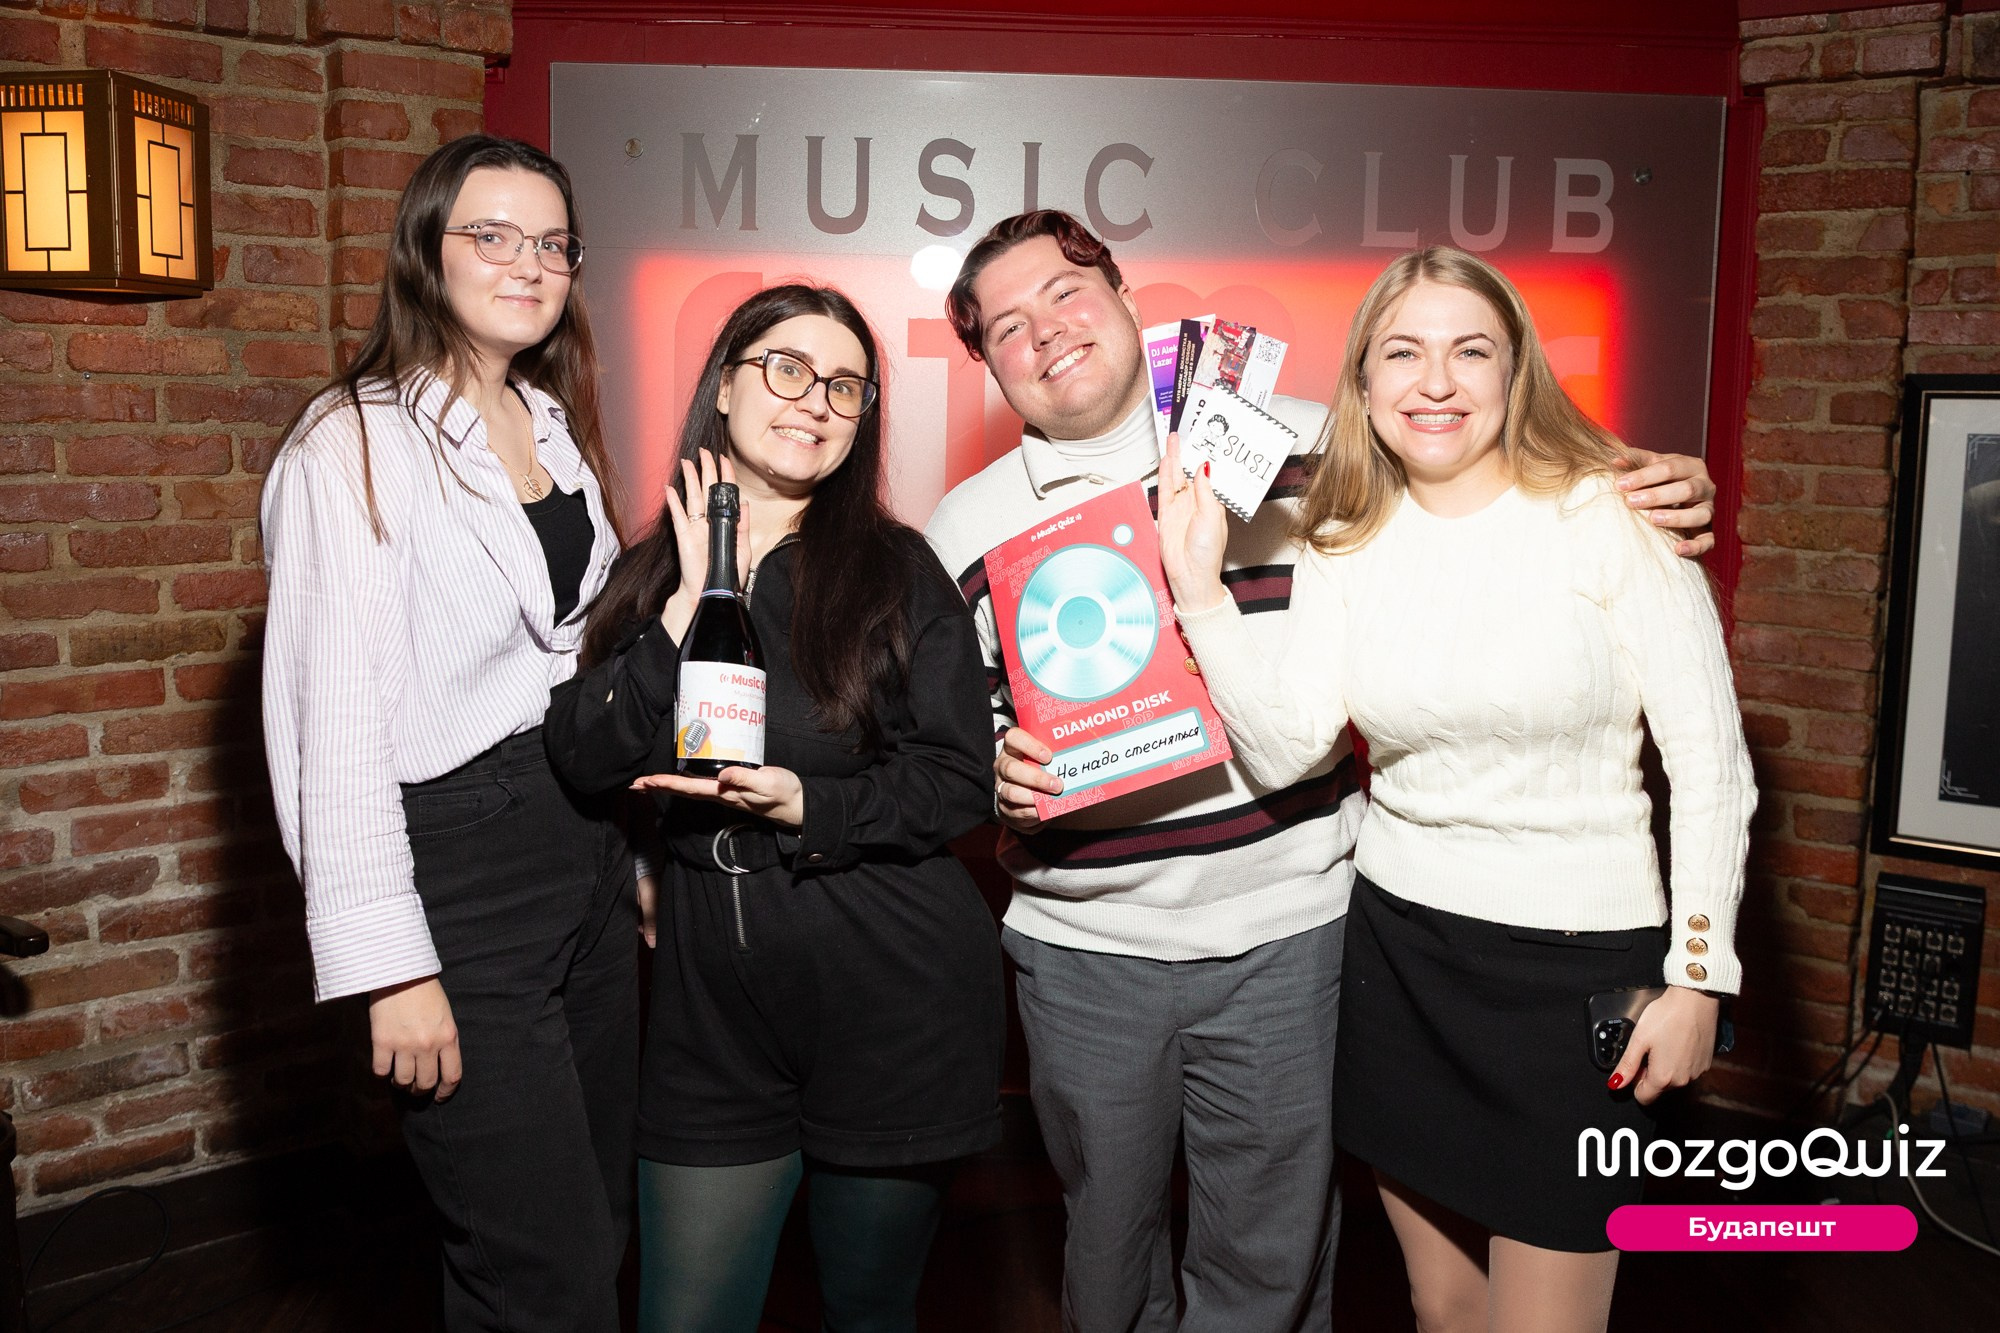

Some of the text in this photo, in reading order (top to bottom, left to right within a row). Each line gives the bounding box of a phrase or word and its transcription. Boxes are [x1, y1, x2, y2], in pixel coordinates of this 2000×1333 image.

[680, 132, 1615, 254] MUSIC CLUB
[1151, 347, 1160, 358] DJ
[1153, 357, 1173, 368] Lazar
[1223, 435, 1275, 482] SUSI
[1036, 516, 1076, 540] Music Quiz
[731, 673, 761, 690] Music
[1052, 690, 1173, 740] DIAMOND DISK
[1056, 762, 1078, 779] Не
[1081, 750, 1119, 773] надо
[1124, 726, 1200, 759] стесняться
